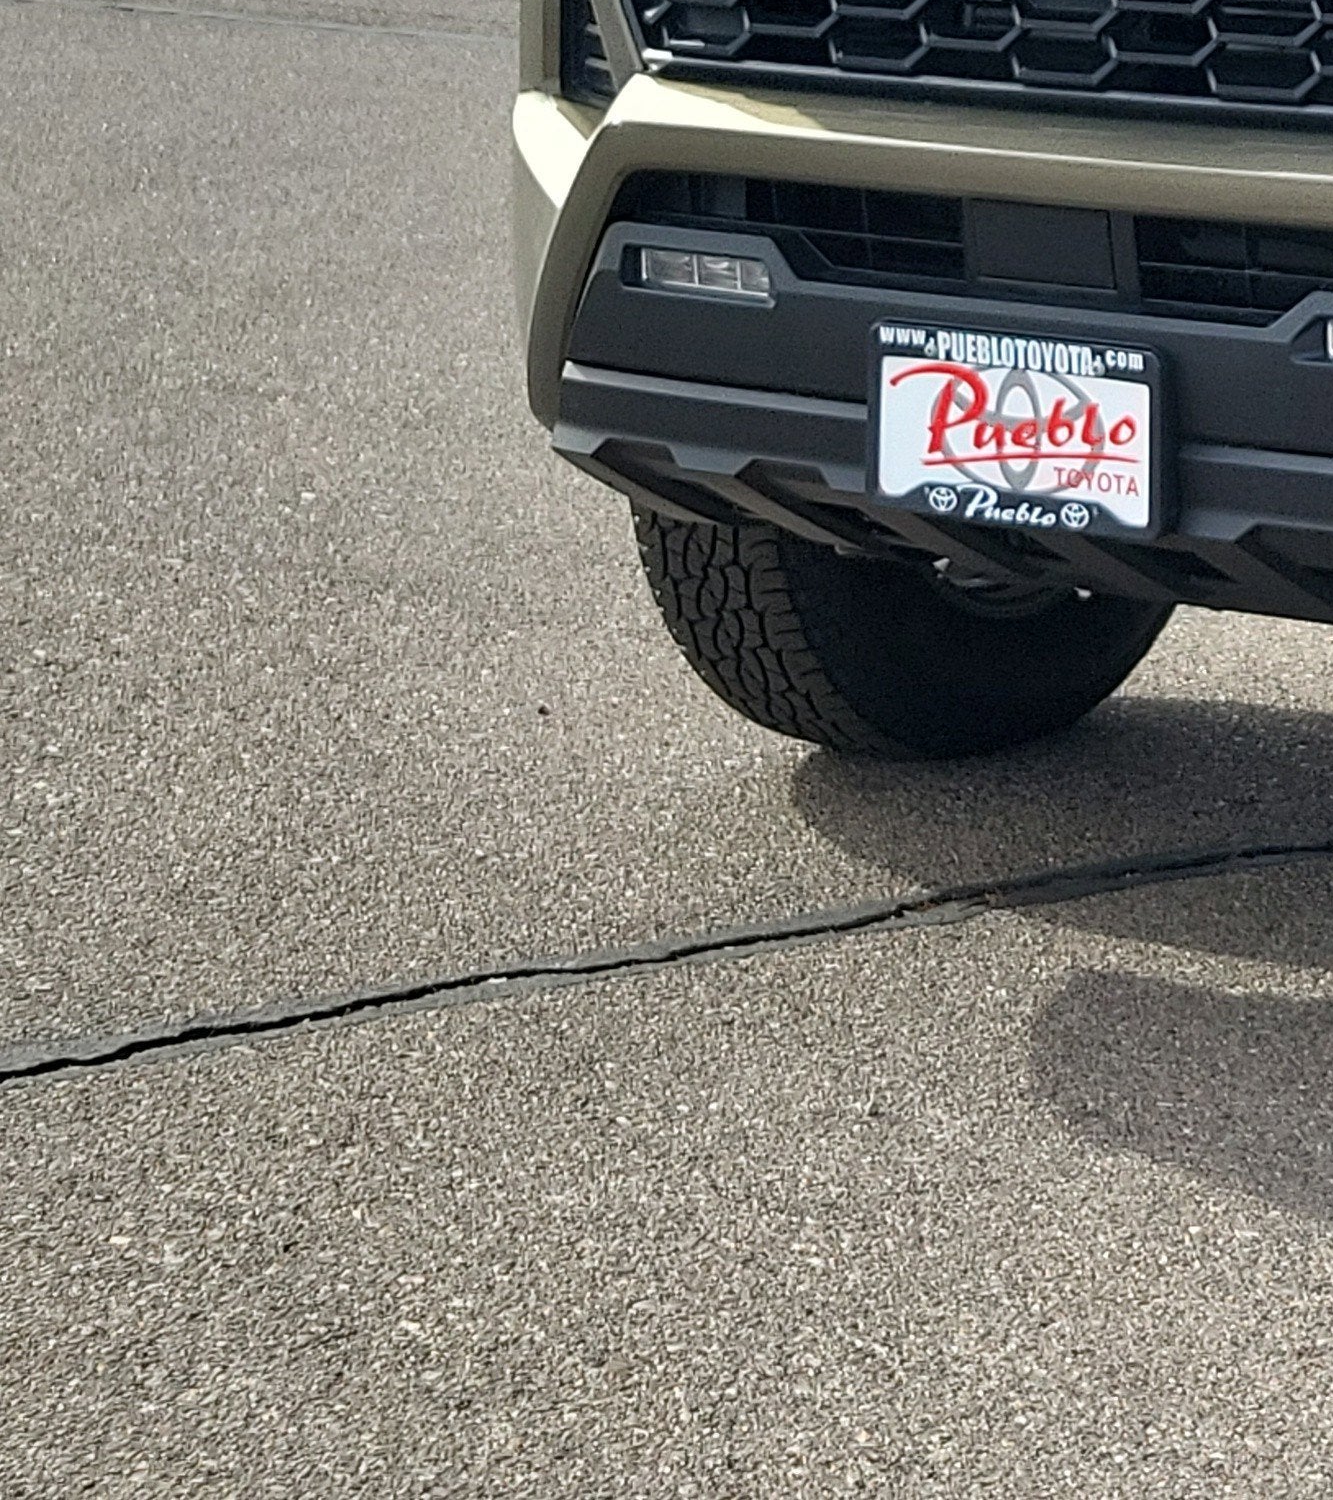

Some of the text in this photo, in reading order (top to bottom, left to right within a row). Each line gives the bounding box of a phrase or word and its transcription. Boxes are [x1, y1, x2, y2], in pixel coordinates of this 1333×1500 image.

[889, 362, 1136, 454] Pueblo
[1053, 466, 1139, 497] TOYOTA
[956, 484, 1057, 527] Pueblo
